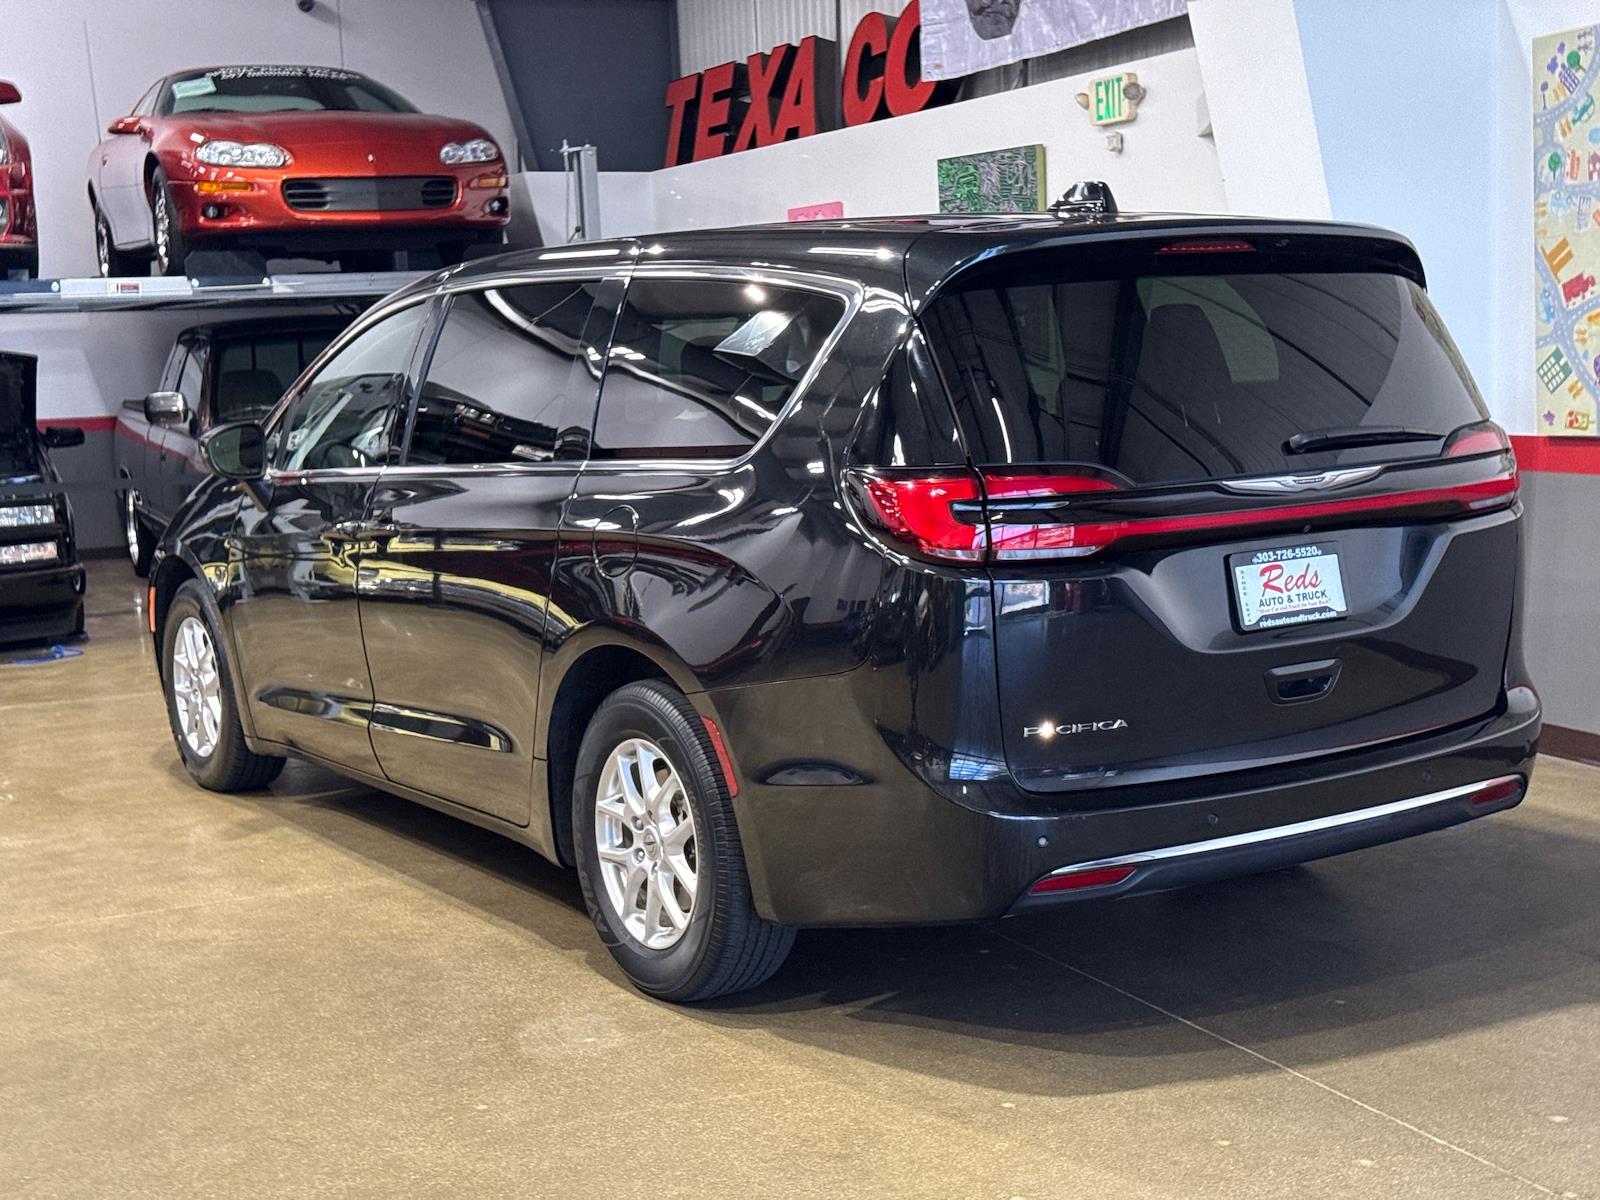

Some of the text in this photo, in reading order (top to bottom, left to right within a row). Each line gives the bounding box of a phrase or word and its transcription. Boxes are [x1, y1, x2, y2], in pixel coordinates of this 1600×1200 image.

[1095, 77, 1122, 121] EXIT
[1256, 546, 1318, 563] 303-726-5520
[1259, 562, 1322, 598] Reds
[1258, 589, 1328, 608] AUTO & TRUCK
